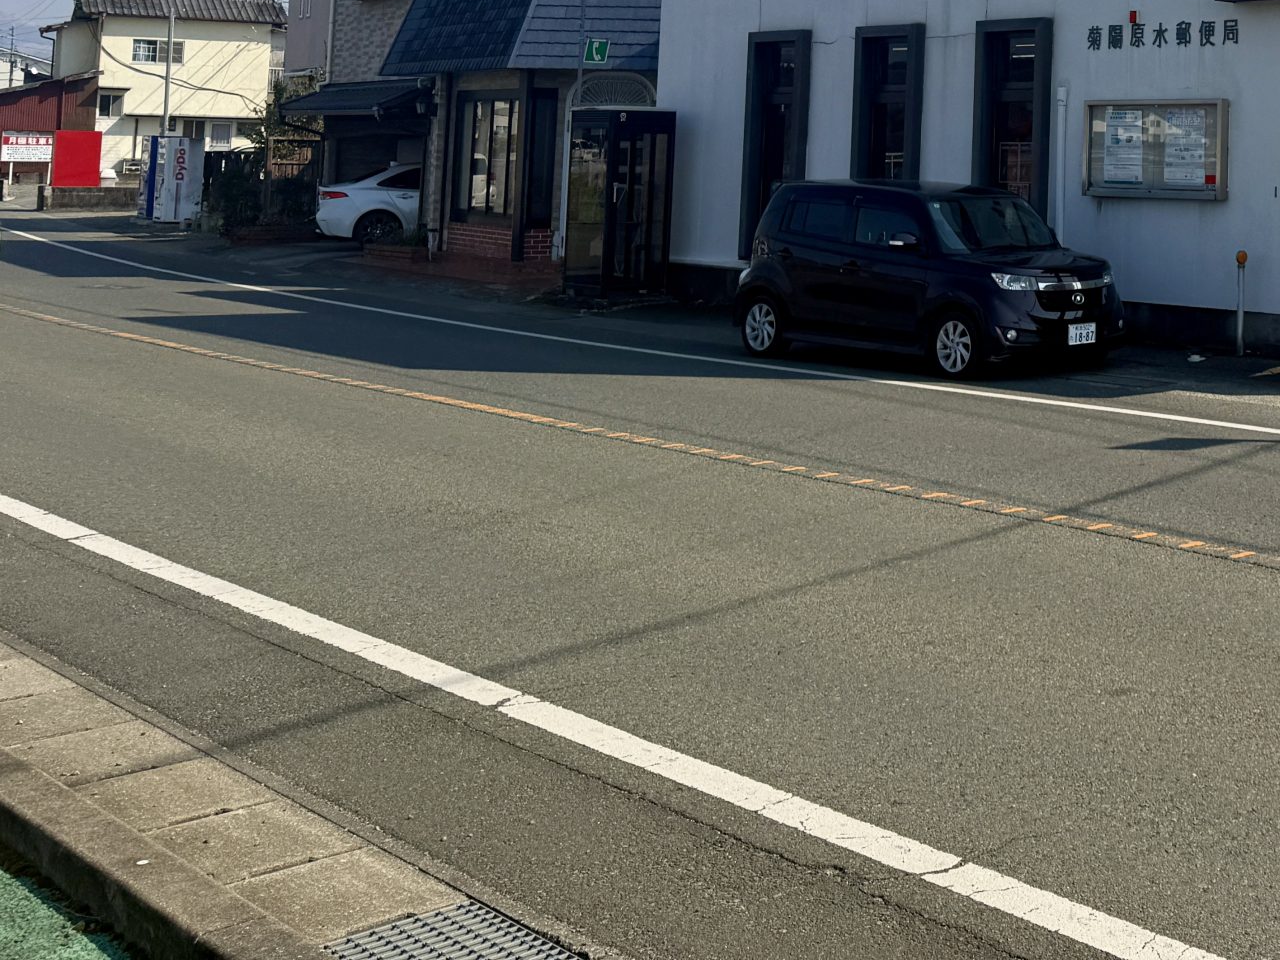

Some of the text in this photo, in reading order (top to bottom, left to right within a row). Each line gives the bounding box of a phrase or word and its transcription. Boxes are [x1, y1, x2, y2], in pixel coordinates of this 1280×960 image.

[1087, 19, 1239, 51] 菊陽原水郵便局
[175, 148, 187, 181] DyDo
